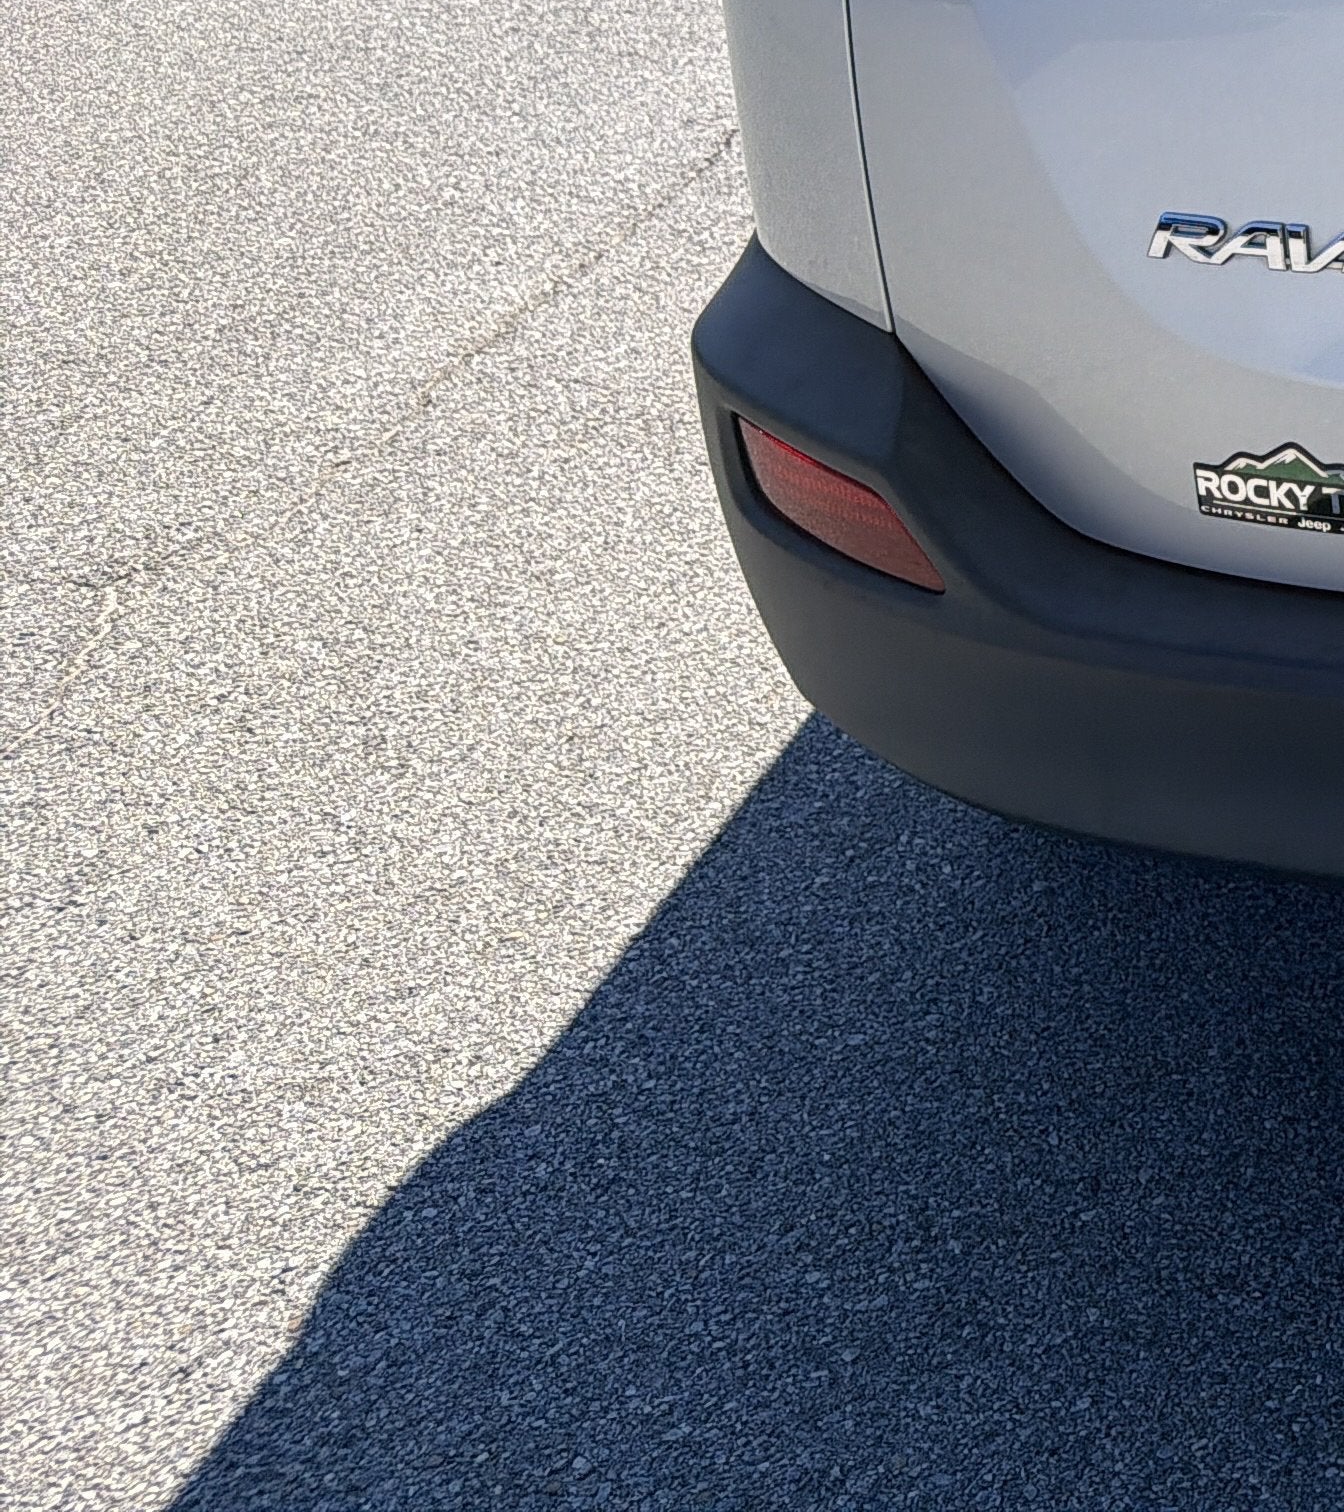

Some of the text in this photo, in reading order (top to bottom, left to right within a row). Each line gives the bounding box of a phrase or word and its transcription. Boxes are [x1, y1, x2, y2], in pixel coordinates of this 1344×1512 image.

[1195, 468, 1316, 511] ROCKY
[1200, 505, 1289, 525] CHRYSLER
[1297, 516, 1332, 533] Jeep
